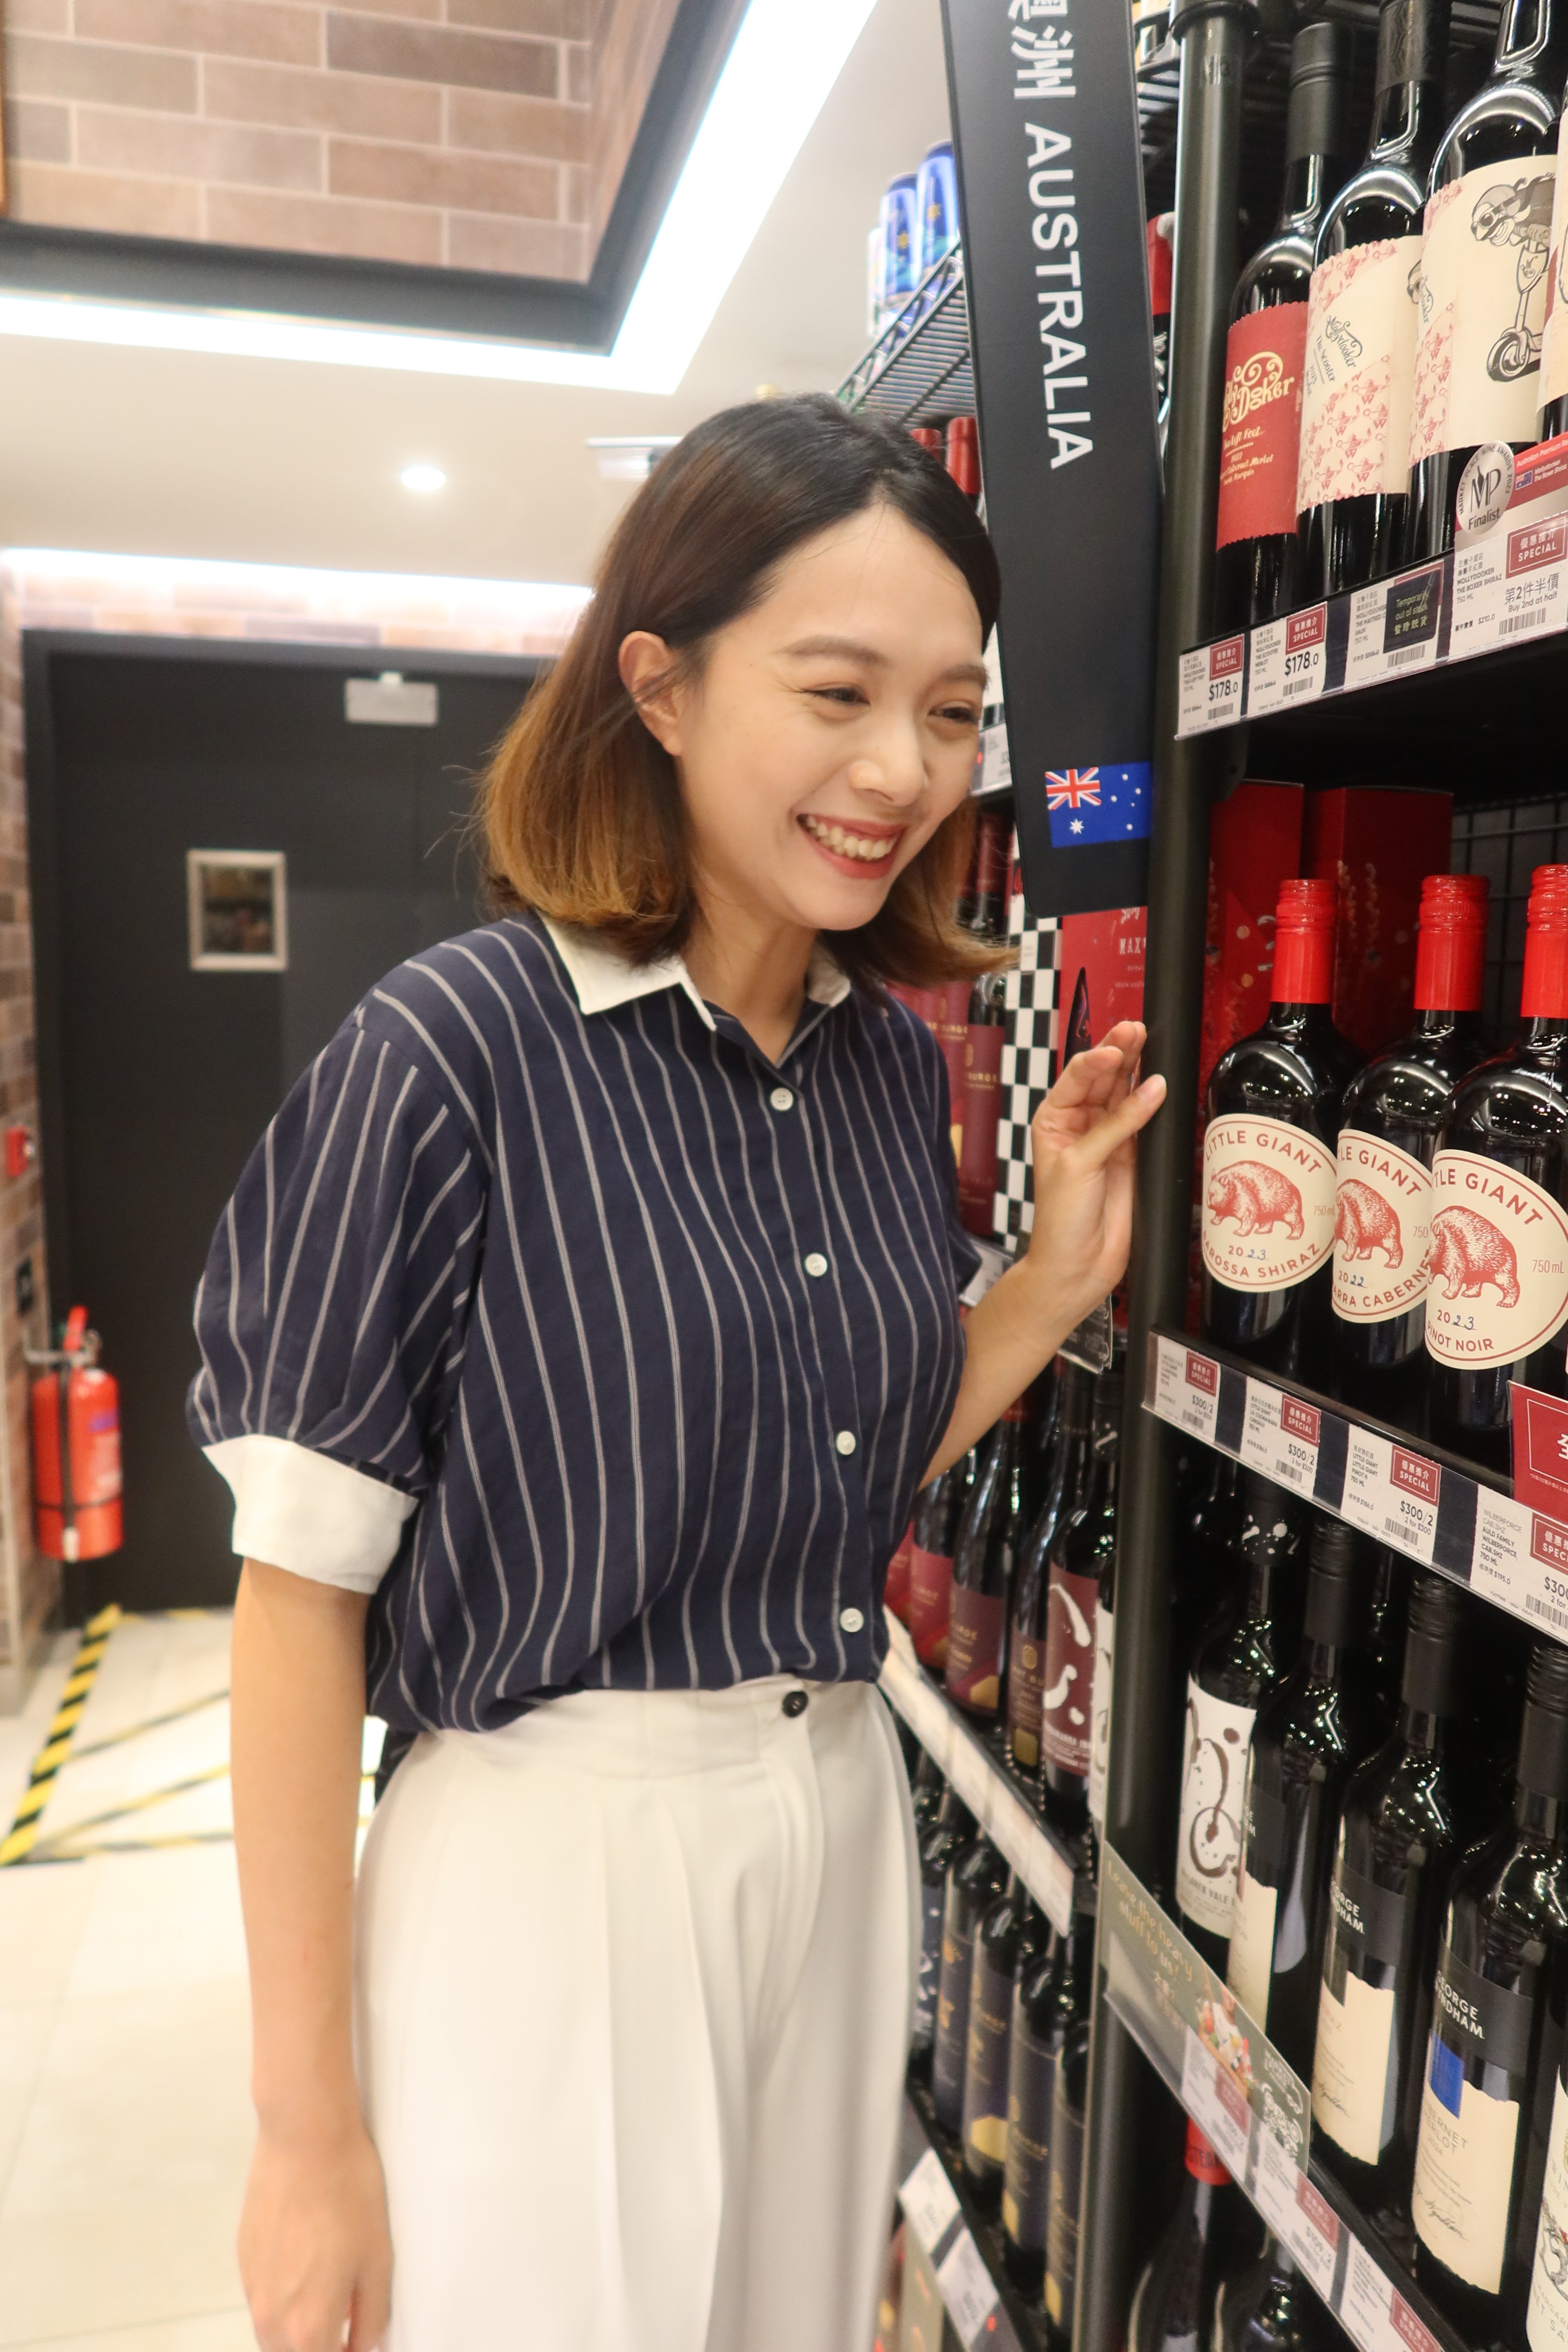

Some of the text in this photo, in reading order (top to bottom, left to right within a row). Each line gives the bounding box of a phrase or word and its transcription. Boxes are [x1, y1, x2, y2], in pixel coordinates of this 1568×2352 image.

[1024, 122, 1093, 470] AUSTRALIA
[1320, 349, 1336, 382] Scooter
[1497, 446, 1513, 472] AWARDS
[1468, 507, 1500, 530] Finalist
[1518, 542, 1558, 563] SPECIAL
[1456, 573, 1502, 594] THE BOXER SHIRAZ
[1457, 567, 1494, 585] MOLLYDOOKER
[1504, 572, 1560, 605] 第2件半價
[1508, 591, 1558, 613] Buy 2nd at half
[1395, 612, 1406, 621] out
[1406, 609, 1412, 618] of
[1293, 628, 1318, 643] SPECIAL
[1216, 657, 1237, 671] SPECIAL
[1285, 651, 1319, 677] $178.0
[1208, 679, 1238, 702] $178.0
[1206, 1130, 1322, 1173] LITTLE GIANT
[1359, 1149, 1422, 1196] GIANT
[1434, 1168, 1543, 1225] TLE GIANT
[1413, 1226, 1428, 1238] 750
[1258, 1243, 1320, 1278] SHIRAZ
[1332, 1283, 1357, 1307] ARRA
[1427, 1320, 1494, 1352] PINOT NOIR
[1192, 1371, 1210, 1386] SPECIAL
[1288, 1417, 1312, 1434] SPECIAL
[1352, 1460, 1378, 1477] LITTLE GIANT
[1353, 1453, 1378, 1468] LITTLE GIANT
[1402, 1459, 1429, 1481] 優惠推介
[1351, 1475, 1359, 1483] 750
[1352, 1468, 1364, 1477] PINOT
[1400, 1470, 1430, 1492] SPECIAL
[1418, 1522, 1431, 1535] $300
[1484, 1509, 1522, 1533] WILBERFORCE
[1482, 1527, 1514, 1547] AULD FAMILY
[1482, 1535, 1517, 1558] WILBERFORCE
[1479, 1551, 1498, 1566] 750 ML
[1494, 1571, 1510, 1585] $195.0
[1556, 1599, 1565, 1609] for
[1332, 1881, 1360, 1917] ORGE
[1109, 1861, 1136, 1907] Leave
[1139, 1900, 1155, 1931] the
[1159, 1923, 1192, 1982] heavy
[1334, 1897, 1364, 1934] DHAM
[1147, 1932, 1157, 1954] to
[1427, 2117, 1457, 2153] ERLOT
